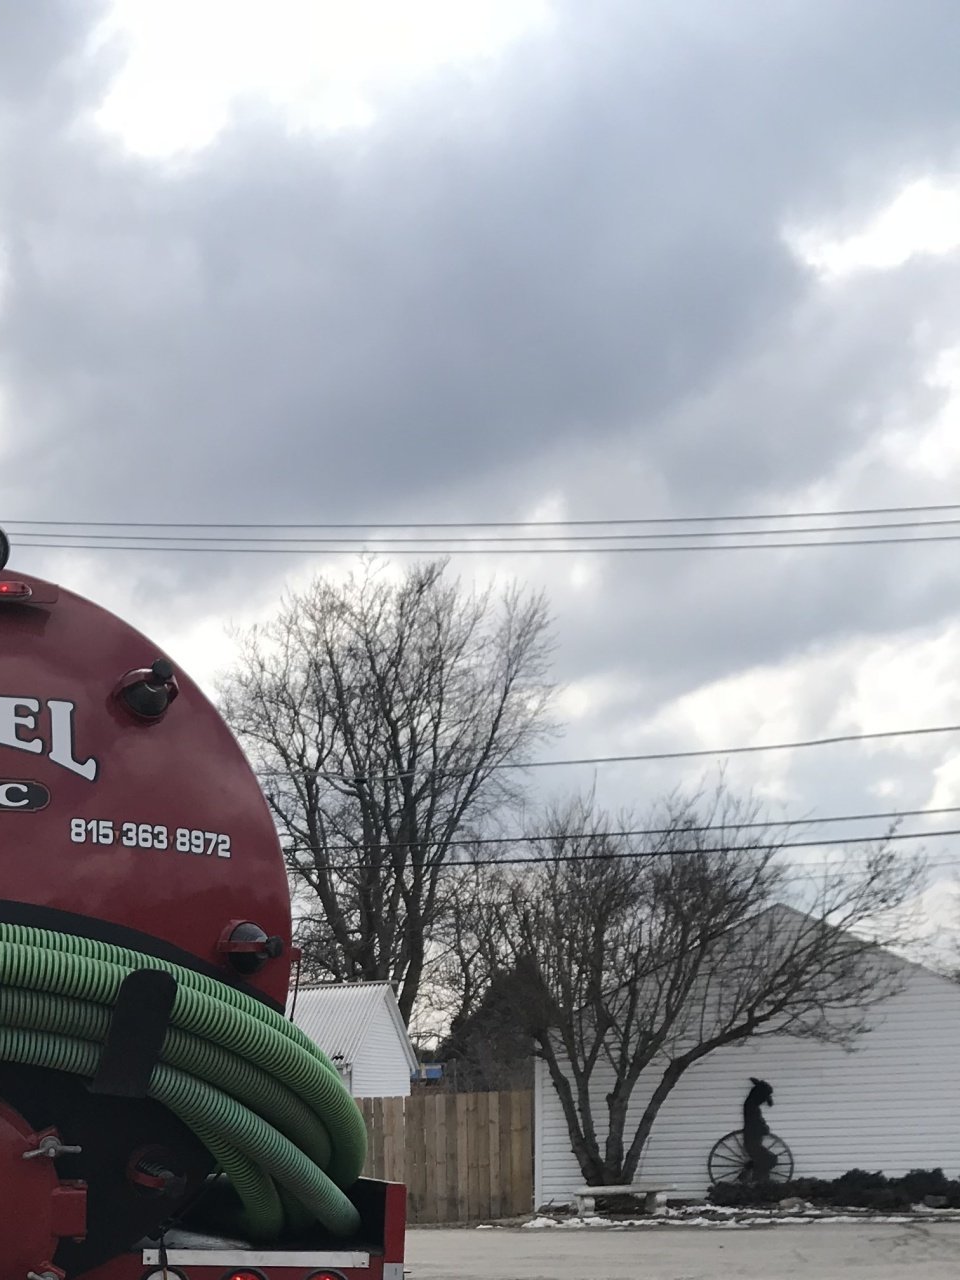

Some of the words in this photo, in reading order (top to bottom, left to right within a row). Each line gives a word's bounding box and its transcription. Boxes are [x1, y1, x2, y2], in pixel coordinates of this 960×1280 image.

[70, 818, 114, 845] 815
[122, 822, 168, 850] 363
[176, 827, 231, 858] 8972
